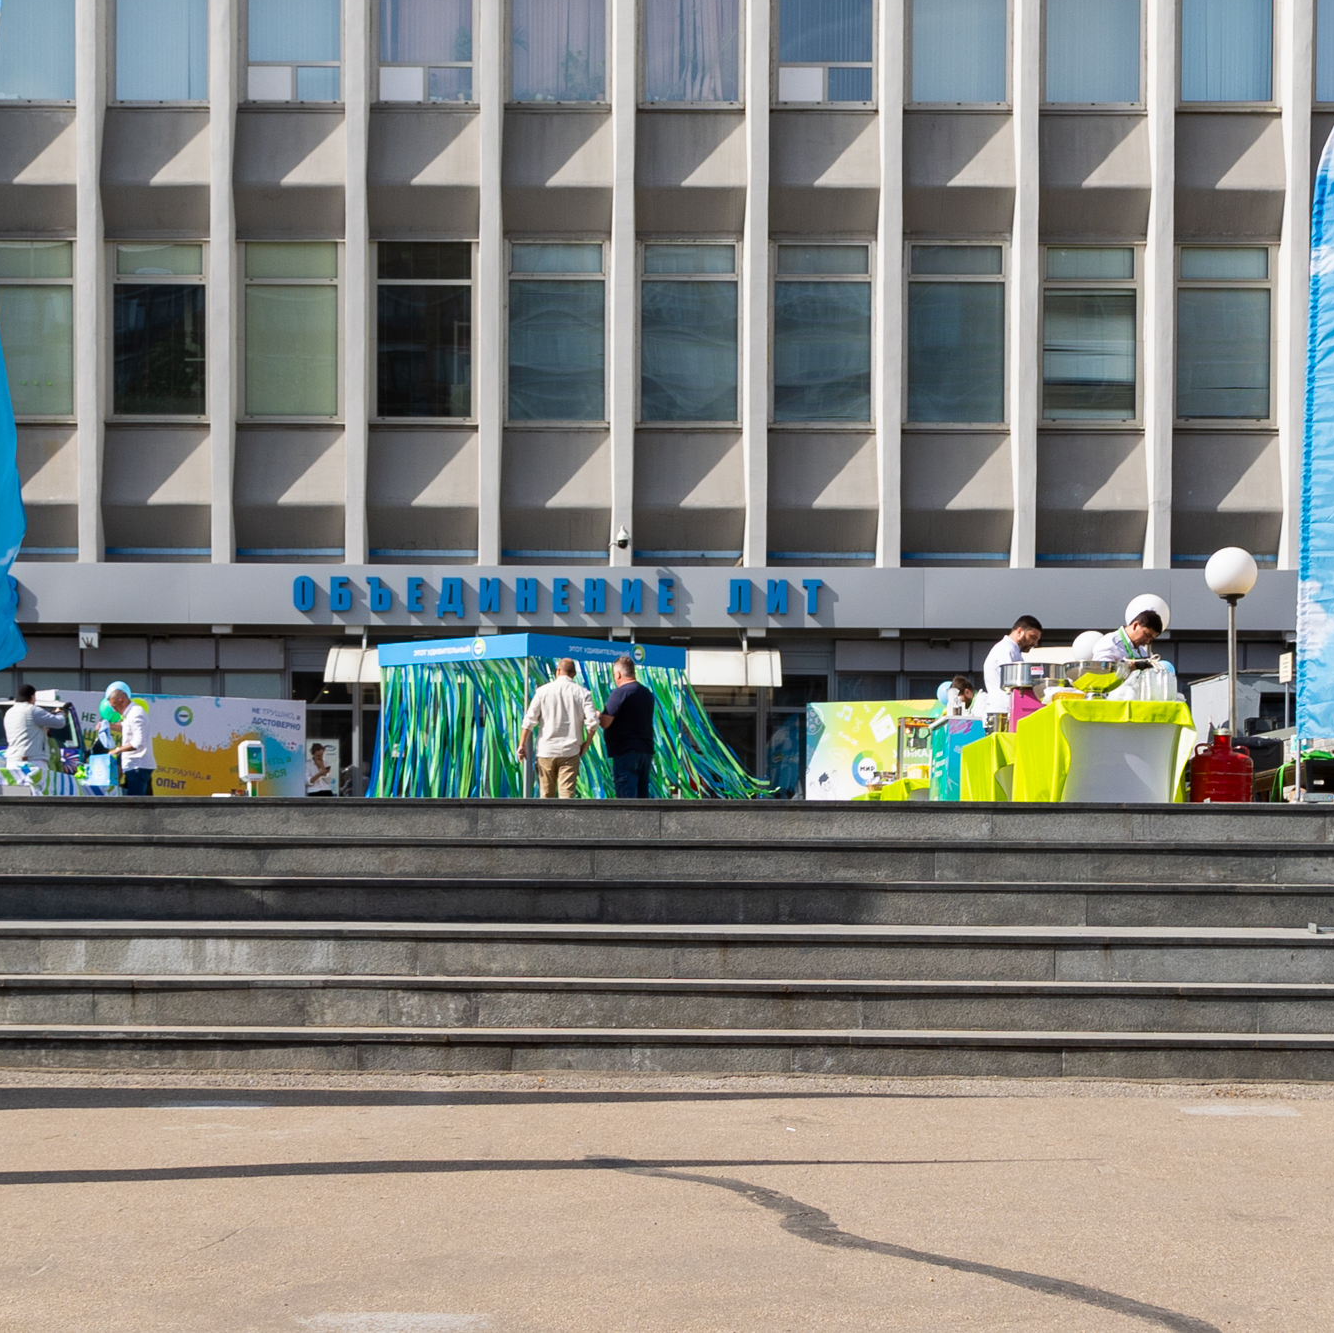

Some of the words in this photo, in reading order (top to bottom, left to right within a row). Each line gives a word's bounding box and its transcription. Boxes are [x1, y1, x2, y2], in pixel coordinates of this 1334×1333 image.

[292, 575, 675, 618] ОБЪЕДИНЕНИЕ
[726, 578, 823, 615] ЛИТ
[81, 711, 97, 723] НЕ
[251, 717, 301, 731] ДОСТОВЕРНО
[156, 777, 186, 790] ОПЫТ
